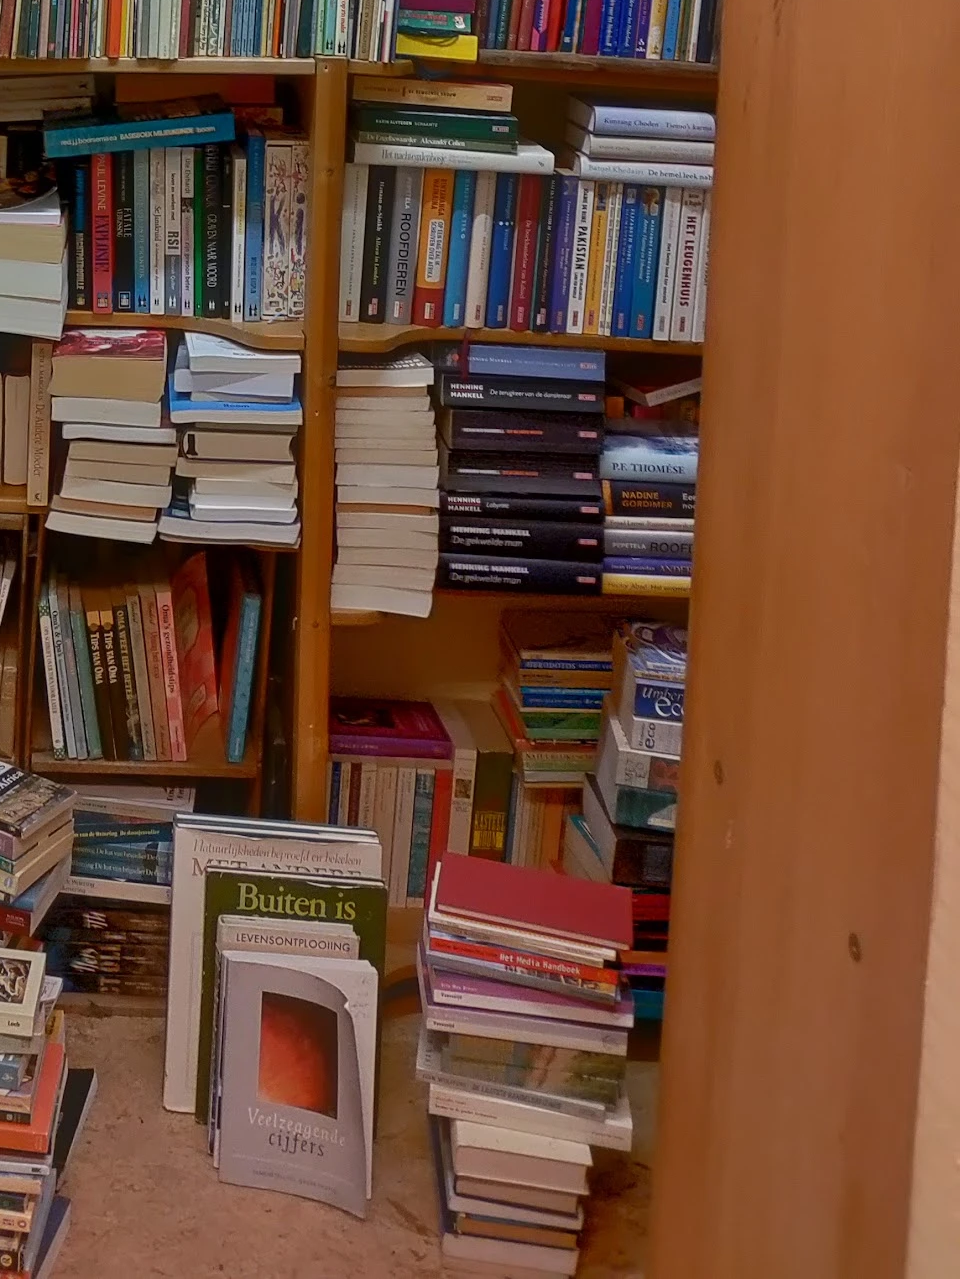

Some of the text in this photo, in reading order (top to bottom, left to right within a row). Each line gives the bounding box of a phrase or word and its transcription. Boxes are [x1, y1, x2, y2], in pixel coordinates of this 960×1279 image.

[420, 137, 465, 147] Alexander Cohen
[97, 154, 106, 211] PAUL LEVINE
[661, 170, 682, 179] hemel
[682, 172, 697, 180] leek
[168, 231, 180, 251] RSI
[575, 226, 588, 269] PAKISTAN
[395, 213, 412, 297] ROOFDIEREN
[679, 215, 697, 307] HET LEUGENHUIS
[450, 383, 484, 391] HENNING
[450, 391, 484, 399] MANKELL
[612, 462, 685, 475] P.F. THOMÉSE
[448, 496, 481, 504] HENNING
[622, 490, 659, 500] NADINE
[622, 500, 673, 509] GORDIMER
[448, 504, 482, 513] MANKELL
[162, 604, 175, 694] Oma's gezondheidstips
[192, 839, 362, 866] Natuurlijkheden beproefd en bekeken
[236, 882, 356, 920] Buiten is
[236, 932, 351, 952] LEVENSONTPLOOIING
[499, 952, 581, 976] Het Media Handboek
[248, 1107, 347, 1148] Veelzeggende
[267, 1131, 326, 1158] cijfers
